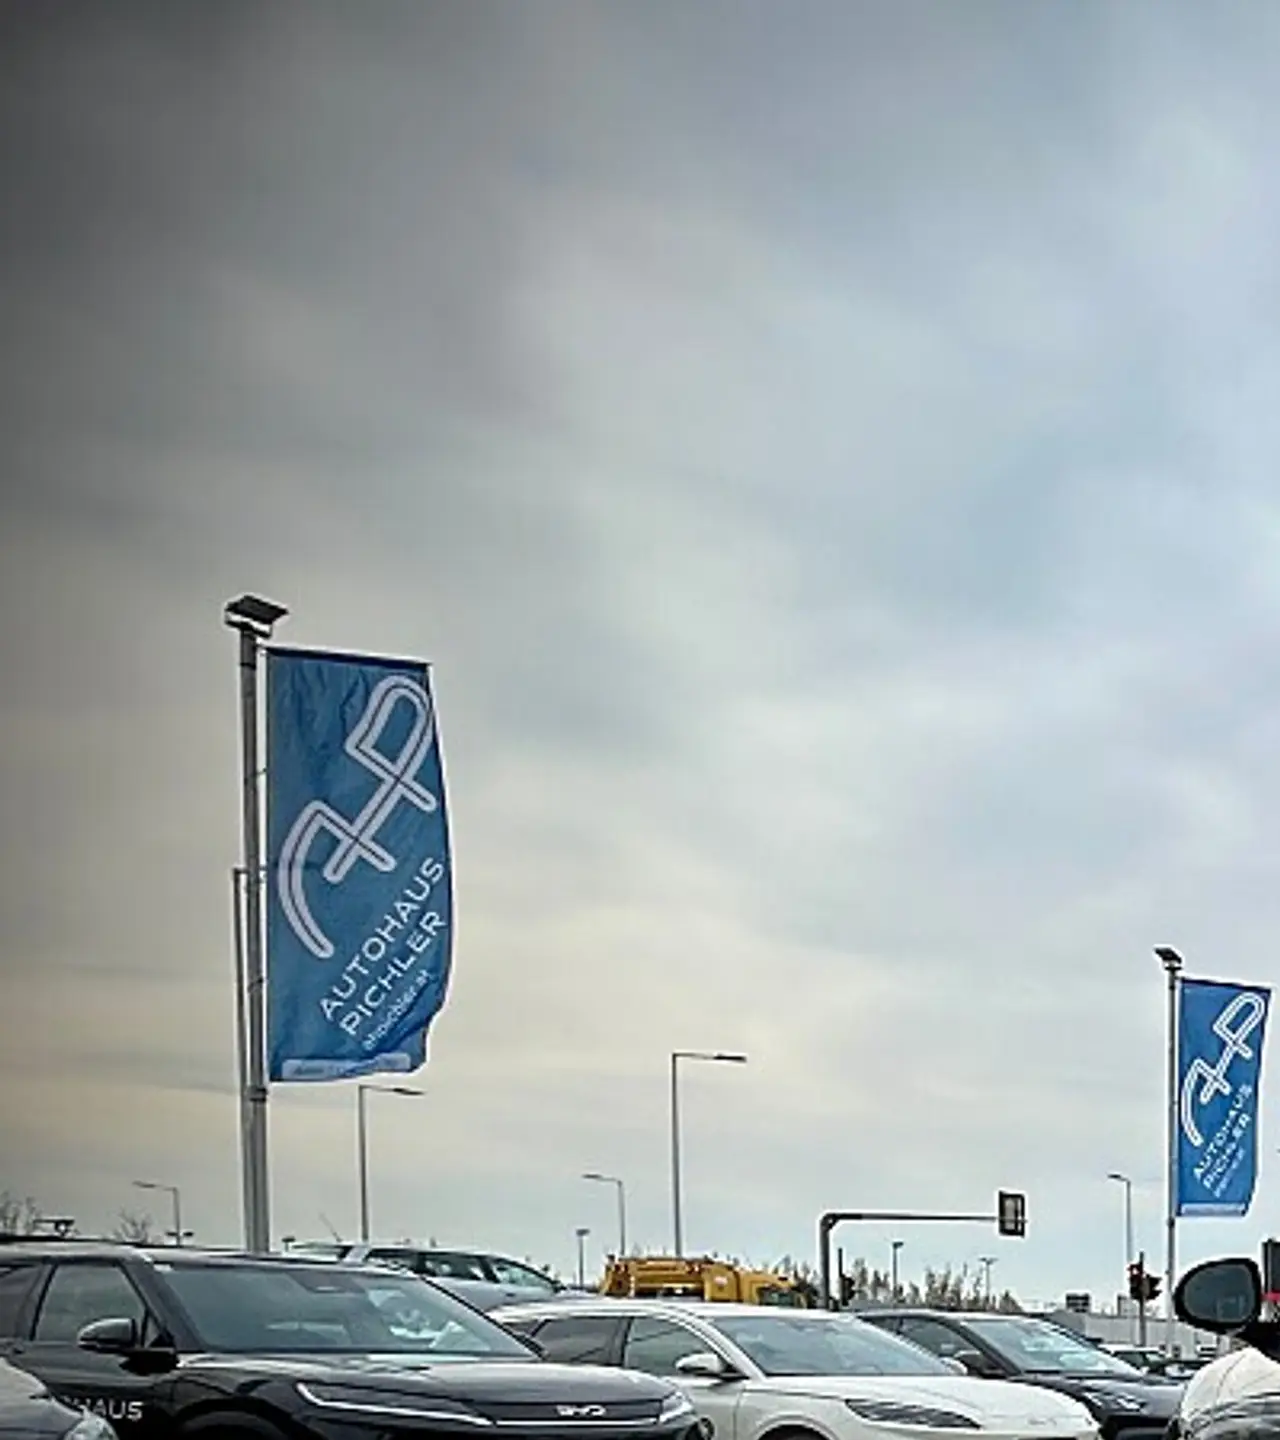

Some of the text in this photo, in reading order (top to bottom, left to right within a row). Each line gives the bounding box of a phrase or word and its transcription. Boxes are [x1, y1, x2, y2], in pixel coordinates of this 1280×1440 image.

[320, 857, 444, 1020] AUTOHAUS
[339, 911, 446, 1035] PICHLER
[1194, 1084, 1253, 1182] AUTOHAUS
[1203, 1113, 1252, 1190] PICHLER
